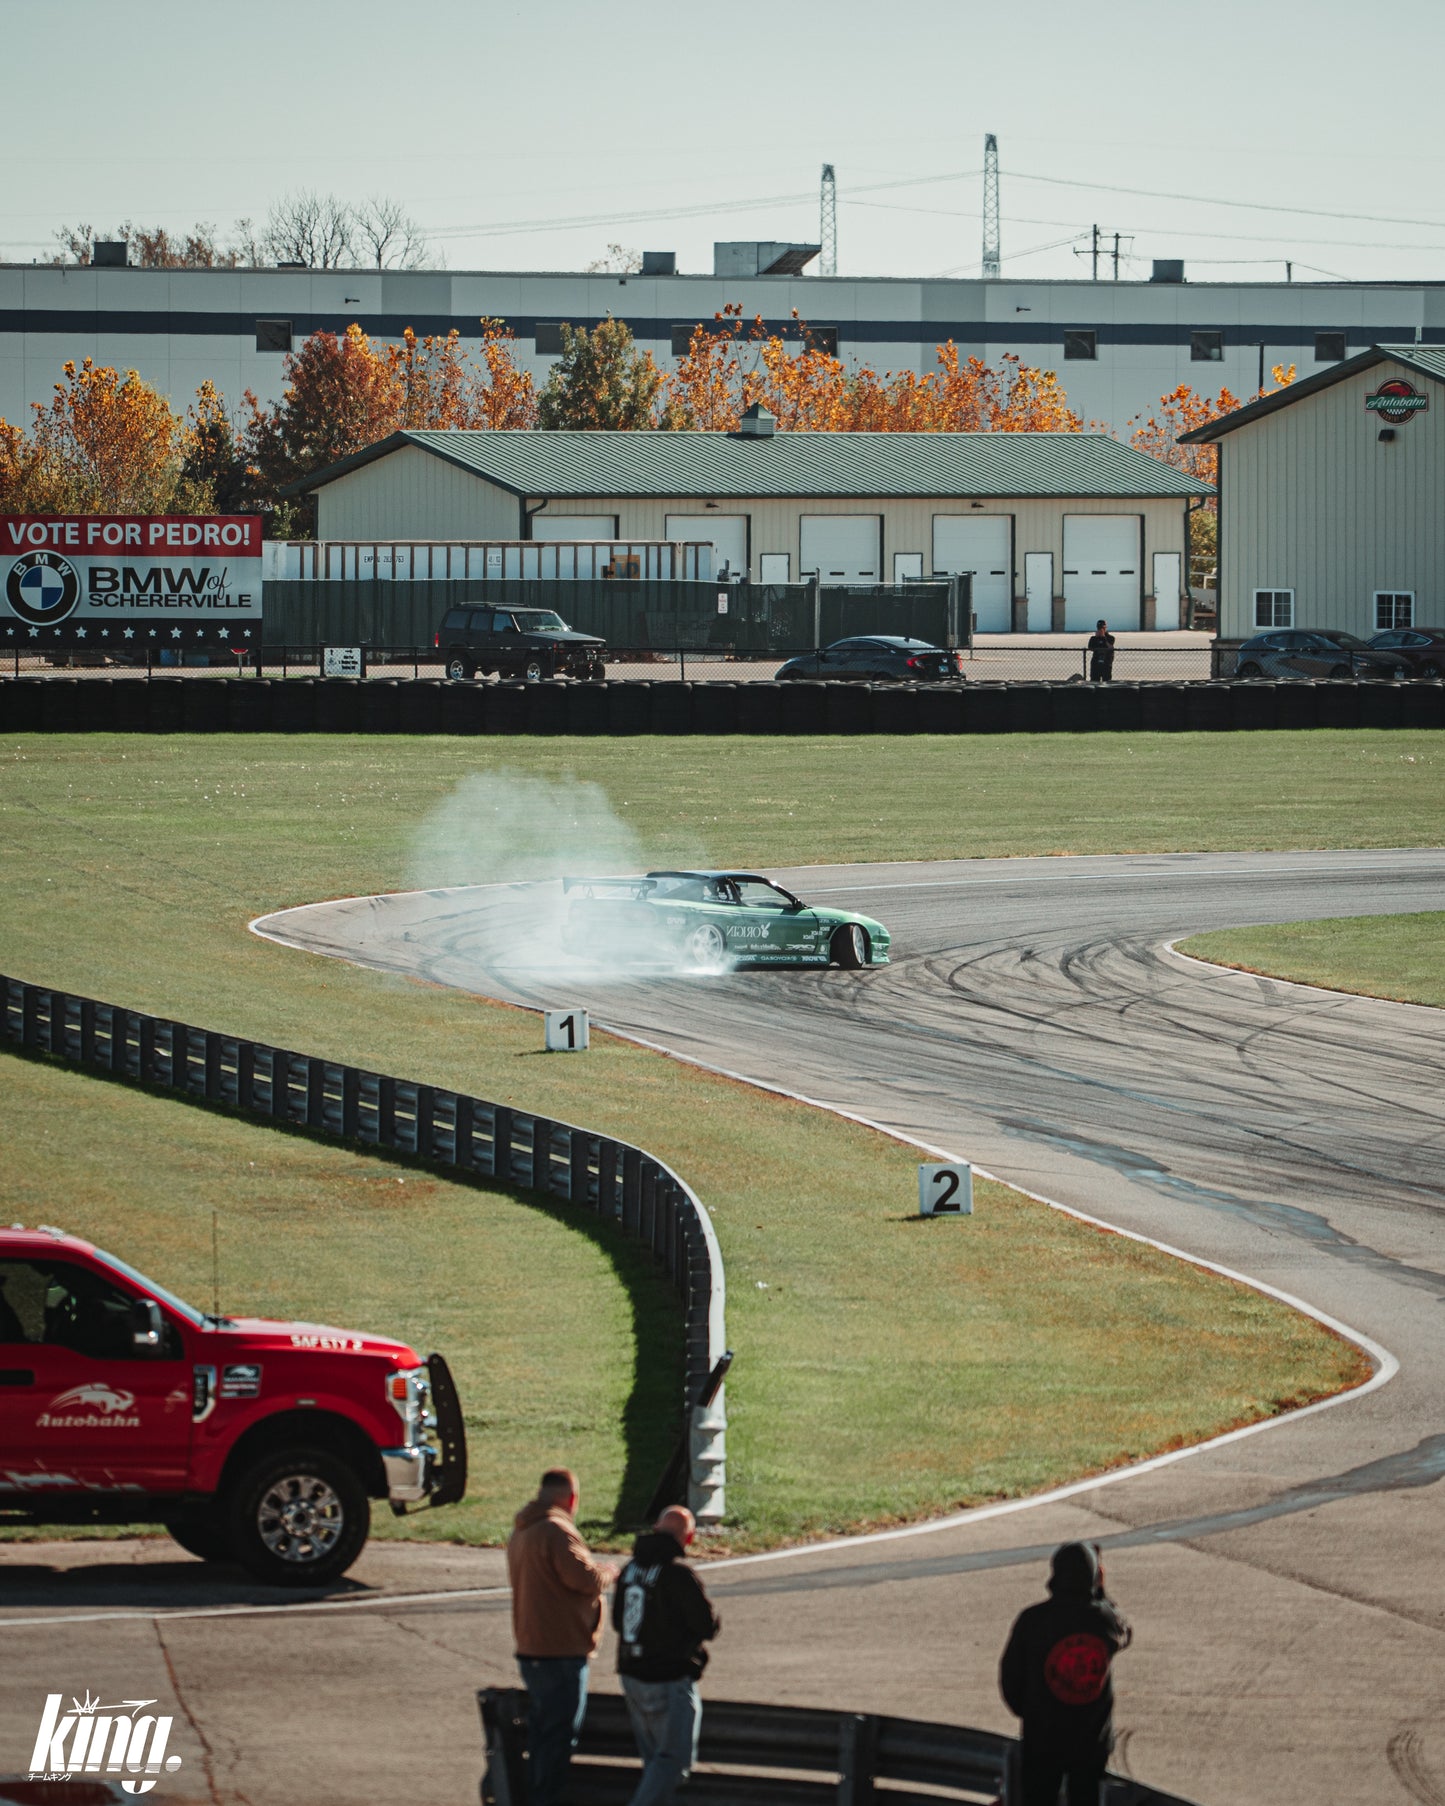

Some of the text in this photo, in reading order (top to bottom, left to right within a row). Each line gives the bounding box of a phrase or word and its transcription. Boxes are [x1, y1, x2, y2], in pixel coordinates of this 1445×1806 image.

[1366, 396, 1426, 409] Autobahn
[8, 522, 250, 546] VOTE FOR PEDRO!
[13, 553, 72, 577] BMW
[88, 566, 232, 600] BMW of
[88, 593, 252, 608] SCHERERVILLE
[559, 1015, 575, 1048] 1
[932, 1170, 960, 1212] 2
[290, 1335, 347, 1351] SAFETY
[36, 1413, 140, 1427] Autobahn
